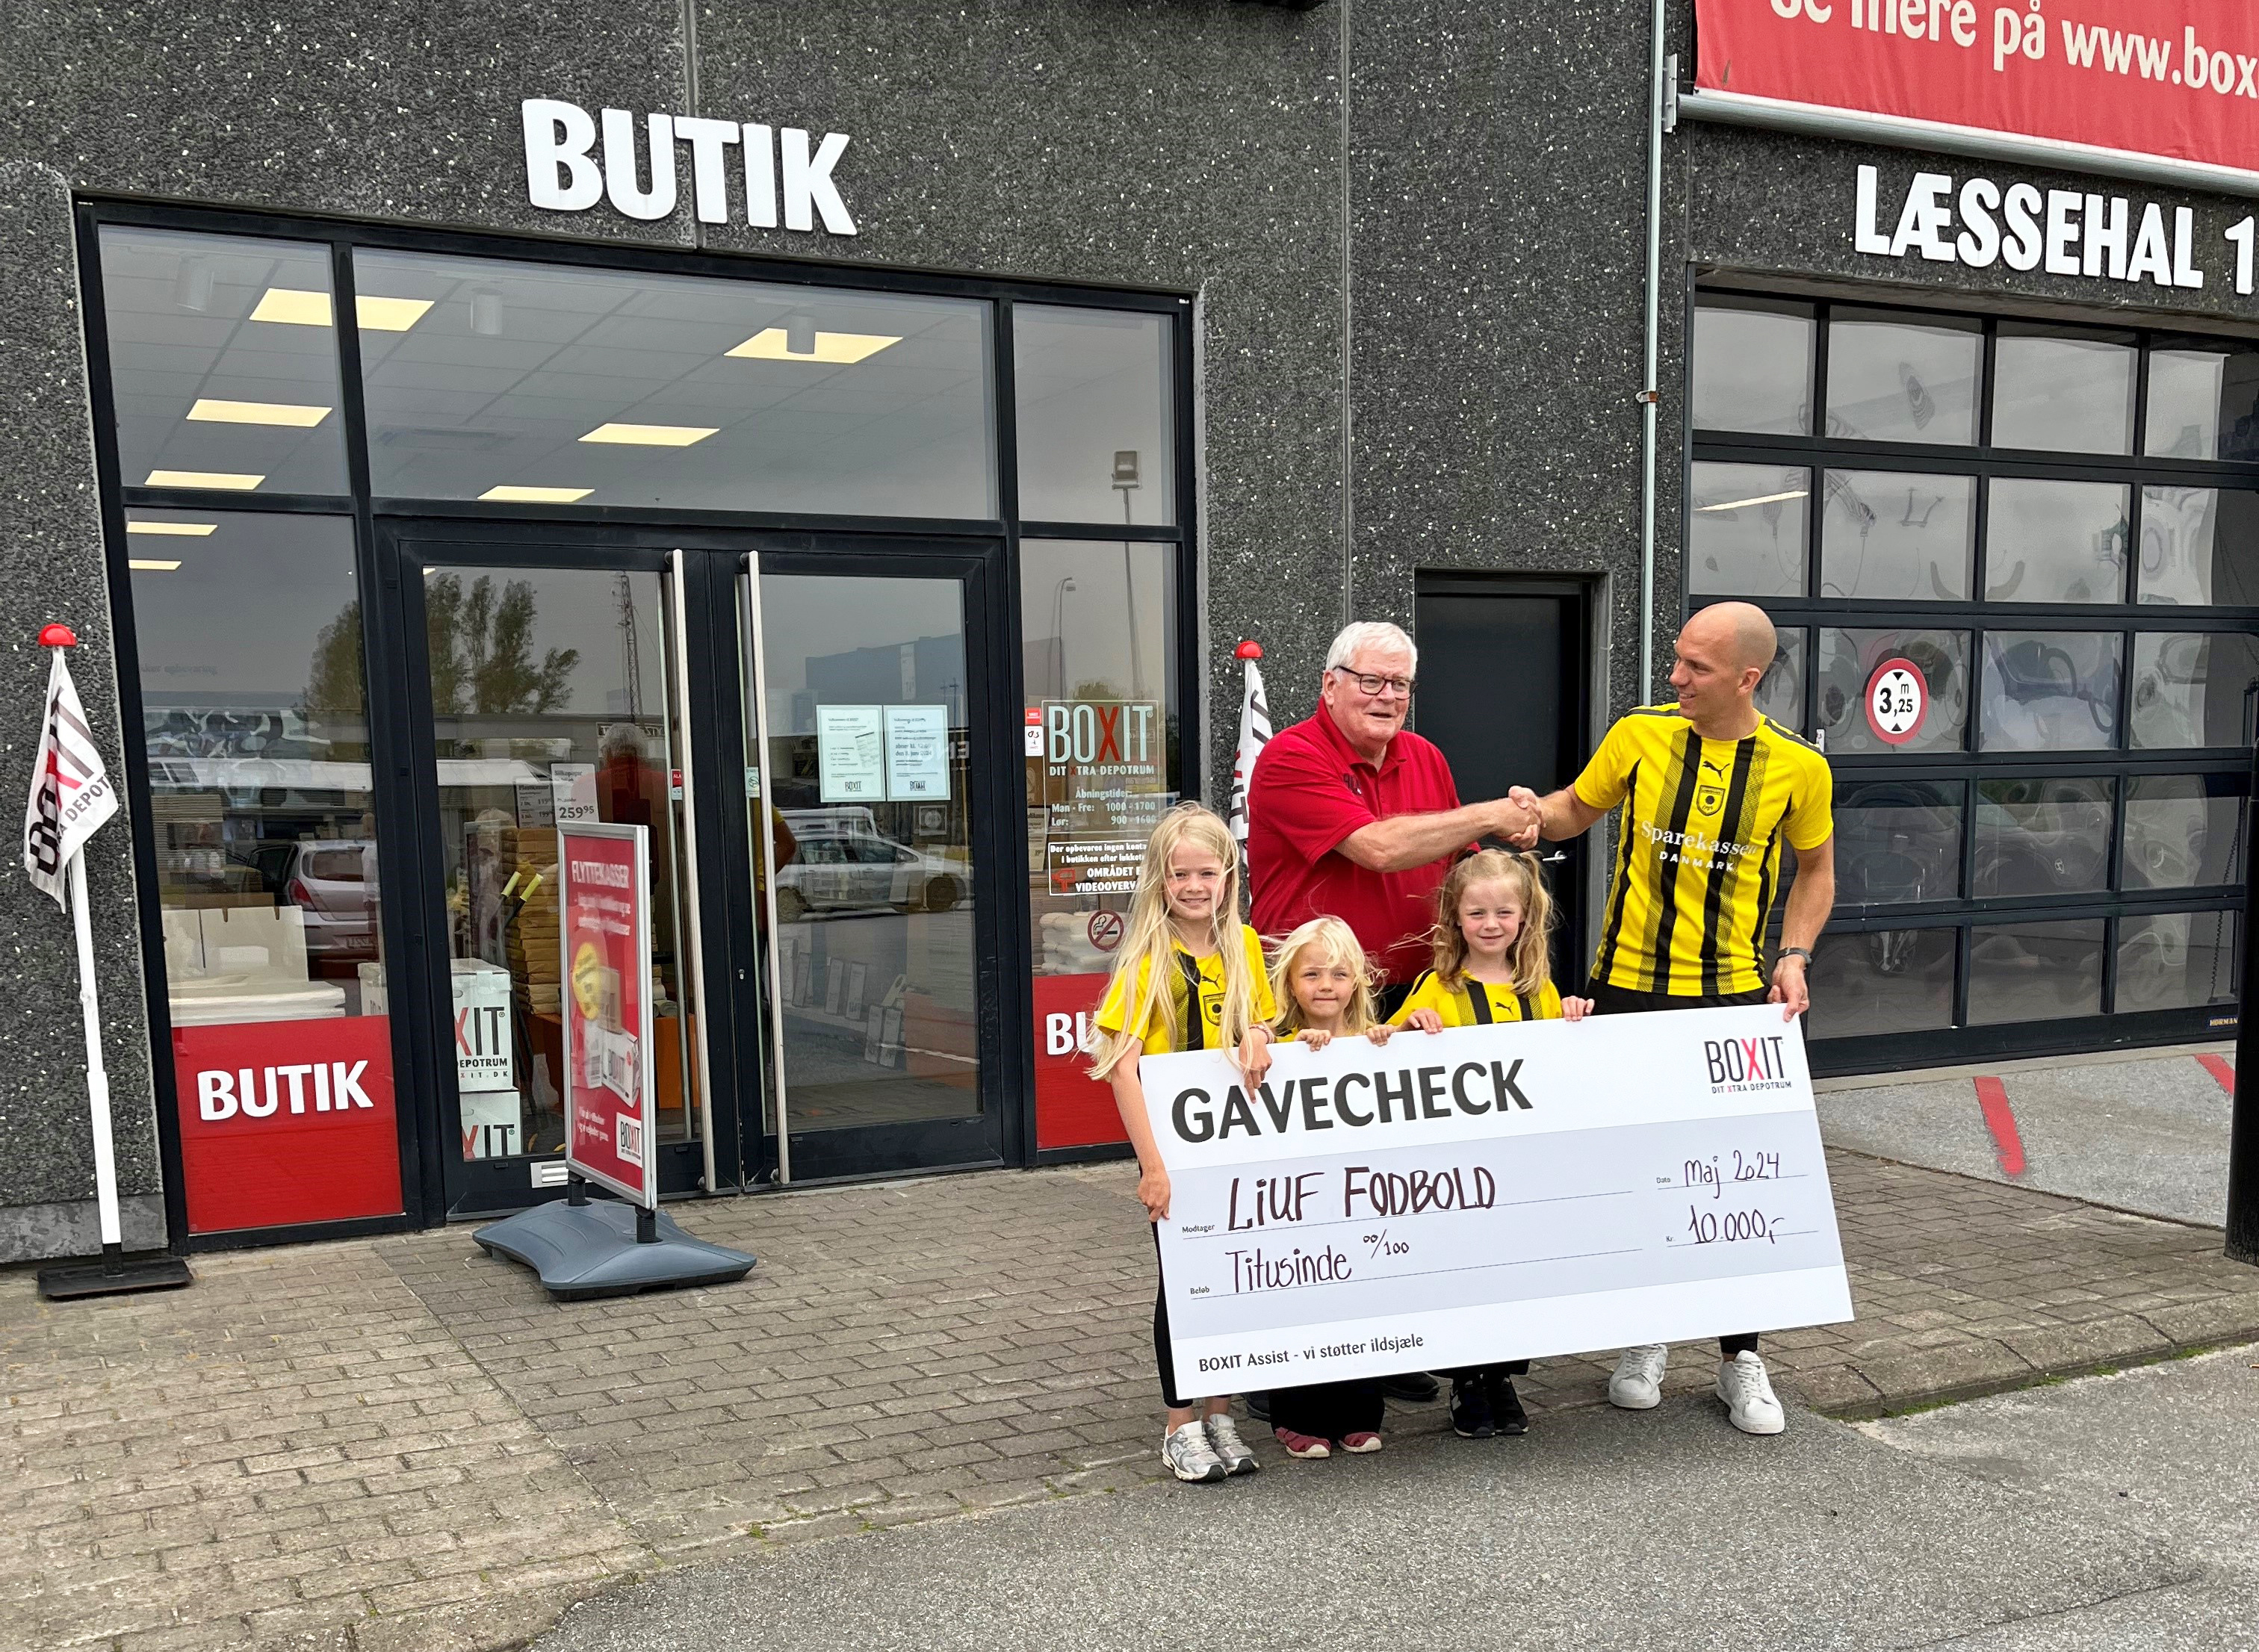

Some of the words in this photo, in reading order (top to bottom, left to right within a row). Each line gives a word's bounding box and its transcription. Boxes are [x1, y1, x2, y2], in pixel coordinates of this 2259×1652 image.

[1850, 0, 1977, 48] mere
[1993, 0, 2046, 72] på
[2061, 19, 2259, 99] www.box
[521, 99, 858, 236] BUTIK
[1854, 164, 2204, 289] LÆSSEHAL
[2224, 216, 2255, 295] 1
[1879, 687, 1913, 718] 3,25
[1900, 683, 1909, 695] m
[1048, 704, 1153, 763] BOXIT
[1050, 766, 1067, 776] DIT
[1070, 766, 1097, 776] XTRA
[1100, 765, 1155, 775] DEPOTRUM
[64, 774, 111, 822] DEPOT
[1052, 803, 1070, 813] Man
[1078, 803, 1095, 812] Fre:
[1105, 802, 1127, 812] 1000
[1134, 801, 1156, 811] 1700
[1075, 786, 1132, 801] Åbningstider:
[1051, 817, 1069, 827] Lør:
[1111, 816, 1127, 825] 900
[1050, 844, 1065, 853] Der
[1065, 844, 1103, 854] opbevares
[1641, 820, 1758, 857] Sparekassen
[1066, 854, 1099, 863] butikken
[1100, 853, 1118, 862] efter
[1086, 864, 1134, 878] OMRÅDET
[1659, 851, 1735, 872] DANMARK
[1075, 881, 1136, 892] VIDEOOVERV
[454, 1007, 505, 1057] XIT
[459, 1058, 508, 1068] EPOTRUM
[460, 1070, 509, 1079] XIT.DK
[1704, 1036, 1785, 1084] BOXIT
[196, 1059, 374, 1122] BUTIK
[1171, 1058, 1534, 1143] GAVECHECK
[1711, 1085, 1725, 1094] DIT
[1727, 1084, 1748, 1093] XTRA
[1750, 1081, 1792, 1091] DEPOTRUM
[462, 1123, 515, 1159] XIT
[1732, 1149, 1779, 1181] 2024
[1344, 1166, 1496, 1218] FODBOLD
[1182, 1223, 1215, 1235] Modtager
[1688, 1204, 1785, 1244] 10.000,-
[1225, 1244, 1352, 1294] Titusinde
[1189, 1286, 1210, 1295] Beløb
[1198, 1354, 1242, 1372] BOXIT
[1247, 1350, 1290, 1367] Assist
[1303, 1346, 1316, 1360] vi
[1320, 1342, 1366, 1358] støtter
[1370, 1333, 1424, 1354] ildsjæle
